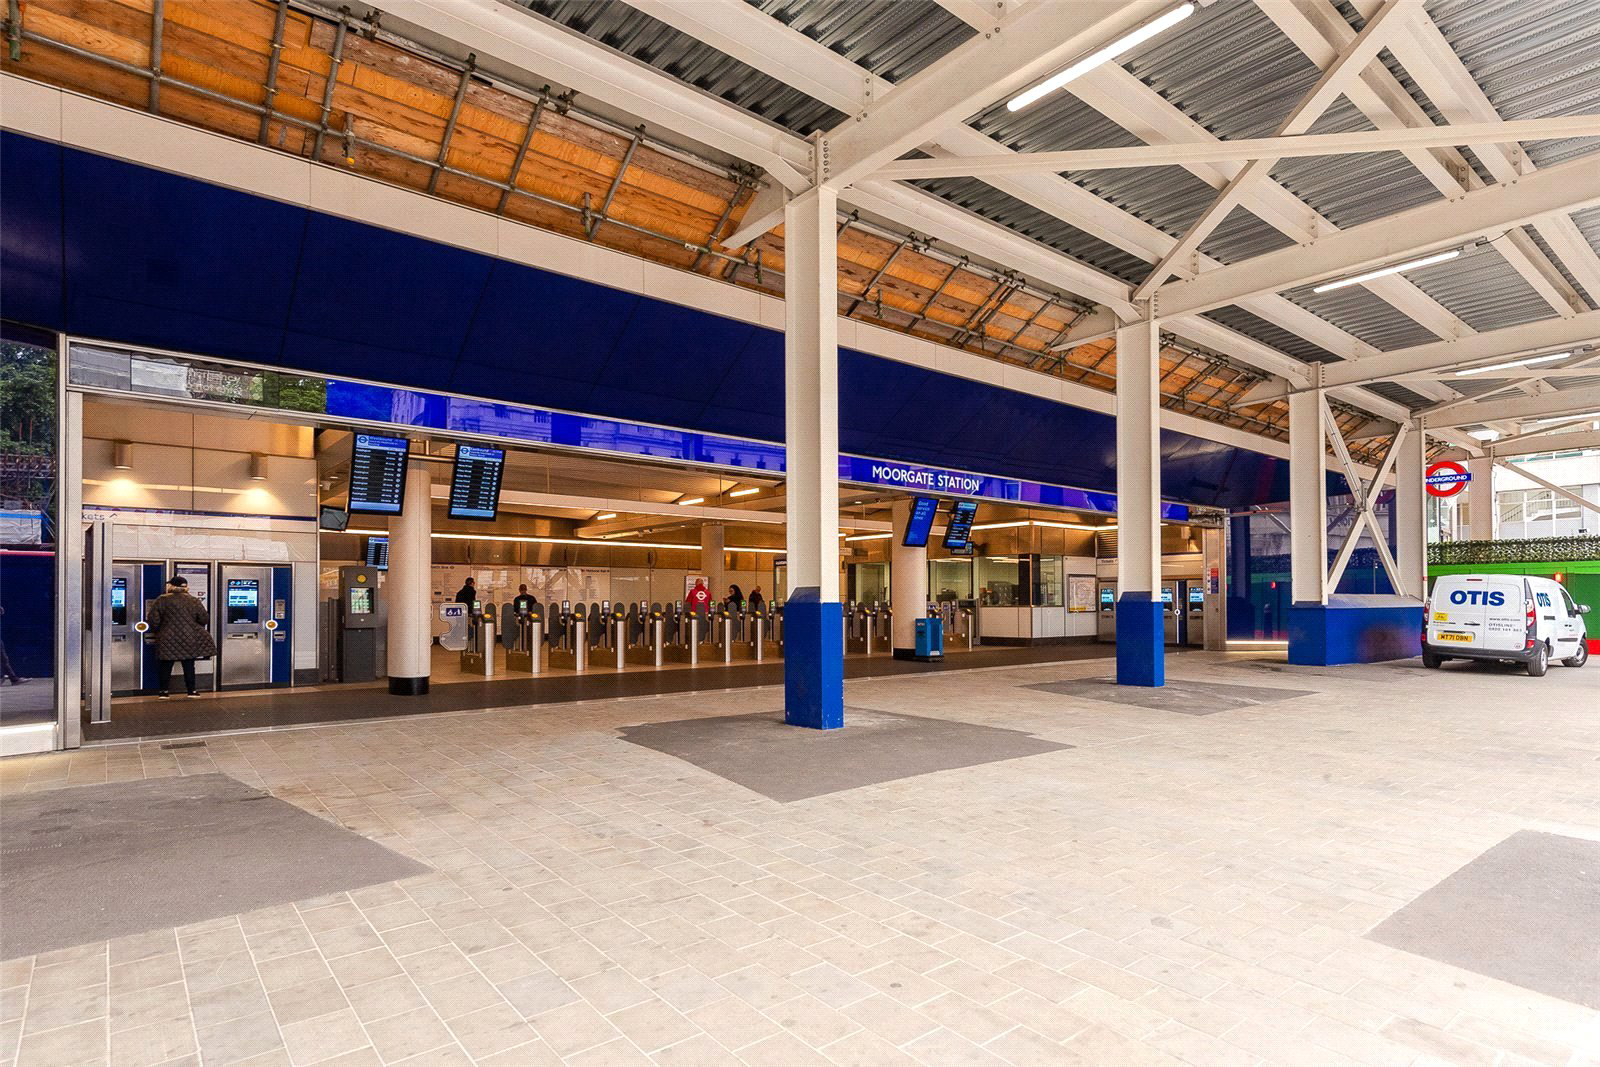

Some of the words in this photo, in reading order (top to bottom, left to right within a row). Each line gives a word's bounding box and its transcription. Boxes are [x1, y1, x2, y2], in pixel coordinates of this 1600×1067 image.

[872, 465, 934, 486] MOORGATE
[937, 474, 980, 491] STATION
[81, 512, 104, 520] kets
[1450, 590, 1504, 606] OTIS
[1536, 592, 1551, 607] OTIS
